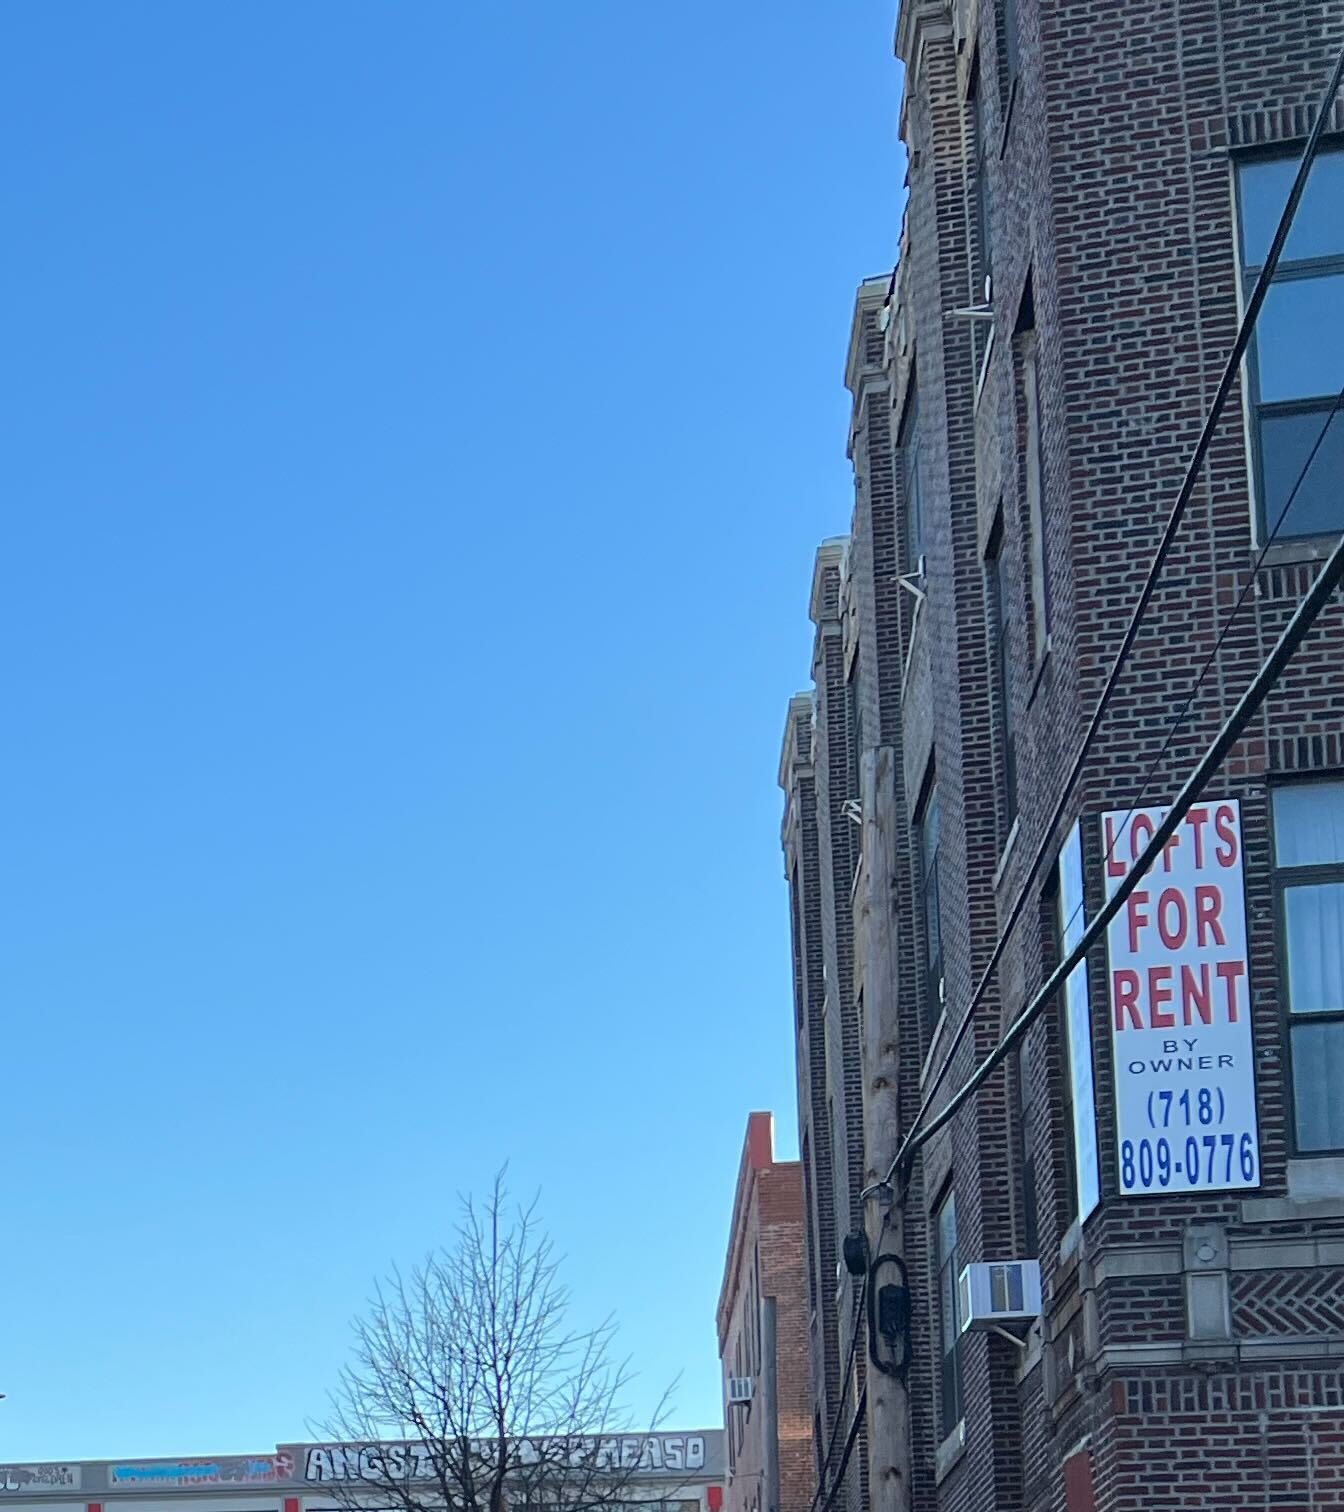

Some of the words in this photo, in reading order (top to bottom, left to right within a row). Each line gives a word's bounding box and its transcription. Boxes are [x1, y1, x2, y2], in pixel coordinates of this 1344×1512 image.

[1105, 805, 1237, 877] LOFTS
[1127, 885, 1226, 952] FOR
[1113, 961, 1244, 1031] RENT
[1128, 1054, 1234, 1075] OWNER
[1163, 1038, 1198, 1053] BY
[1147, 1086, 1225, 1129] (718)
[1121, 1132, 1254, 1189] 809-0776
